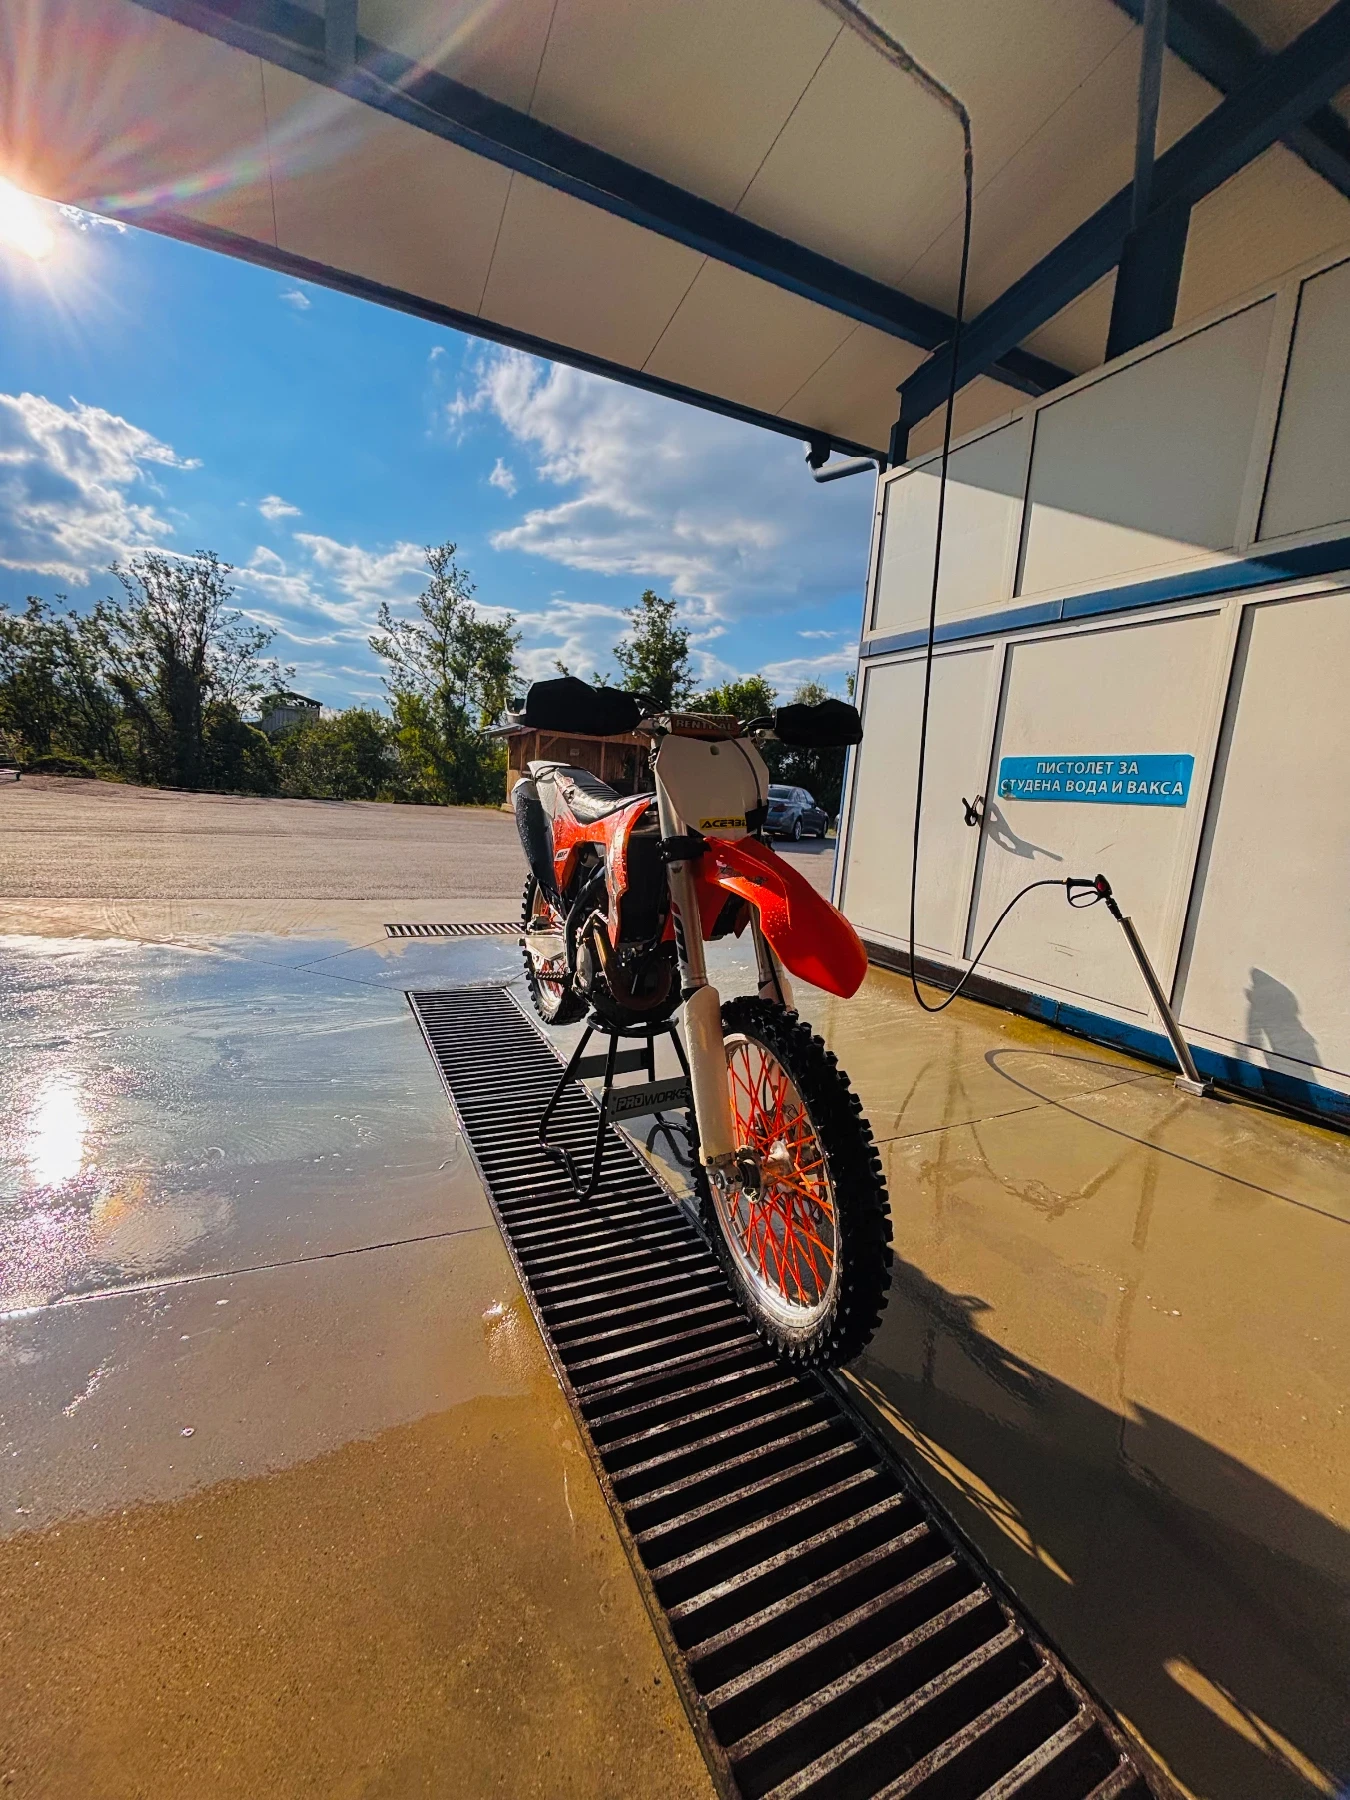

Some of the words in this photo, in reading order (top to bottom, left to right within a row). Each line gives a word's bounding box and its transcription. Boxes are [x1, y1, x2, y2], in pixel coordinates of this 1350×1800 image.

[1036, 761, 1114, 775] ПИСТОЛЕТ
[1118, 761, 1139, 775] ЗА
[1000, 779, 1061, 793] СТУДЕНА
[1065, 780, 1108, 796] ВОДА
[1111, 780, 1123, 794] И
[1126, 780, 1184, 796] ВАКСА
[701, 818, 748, 829] ACERBI
